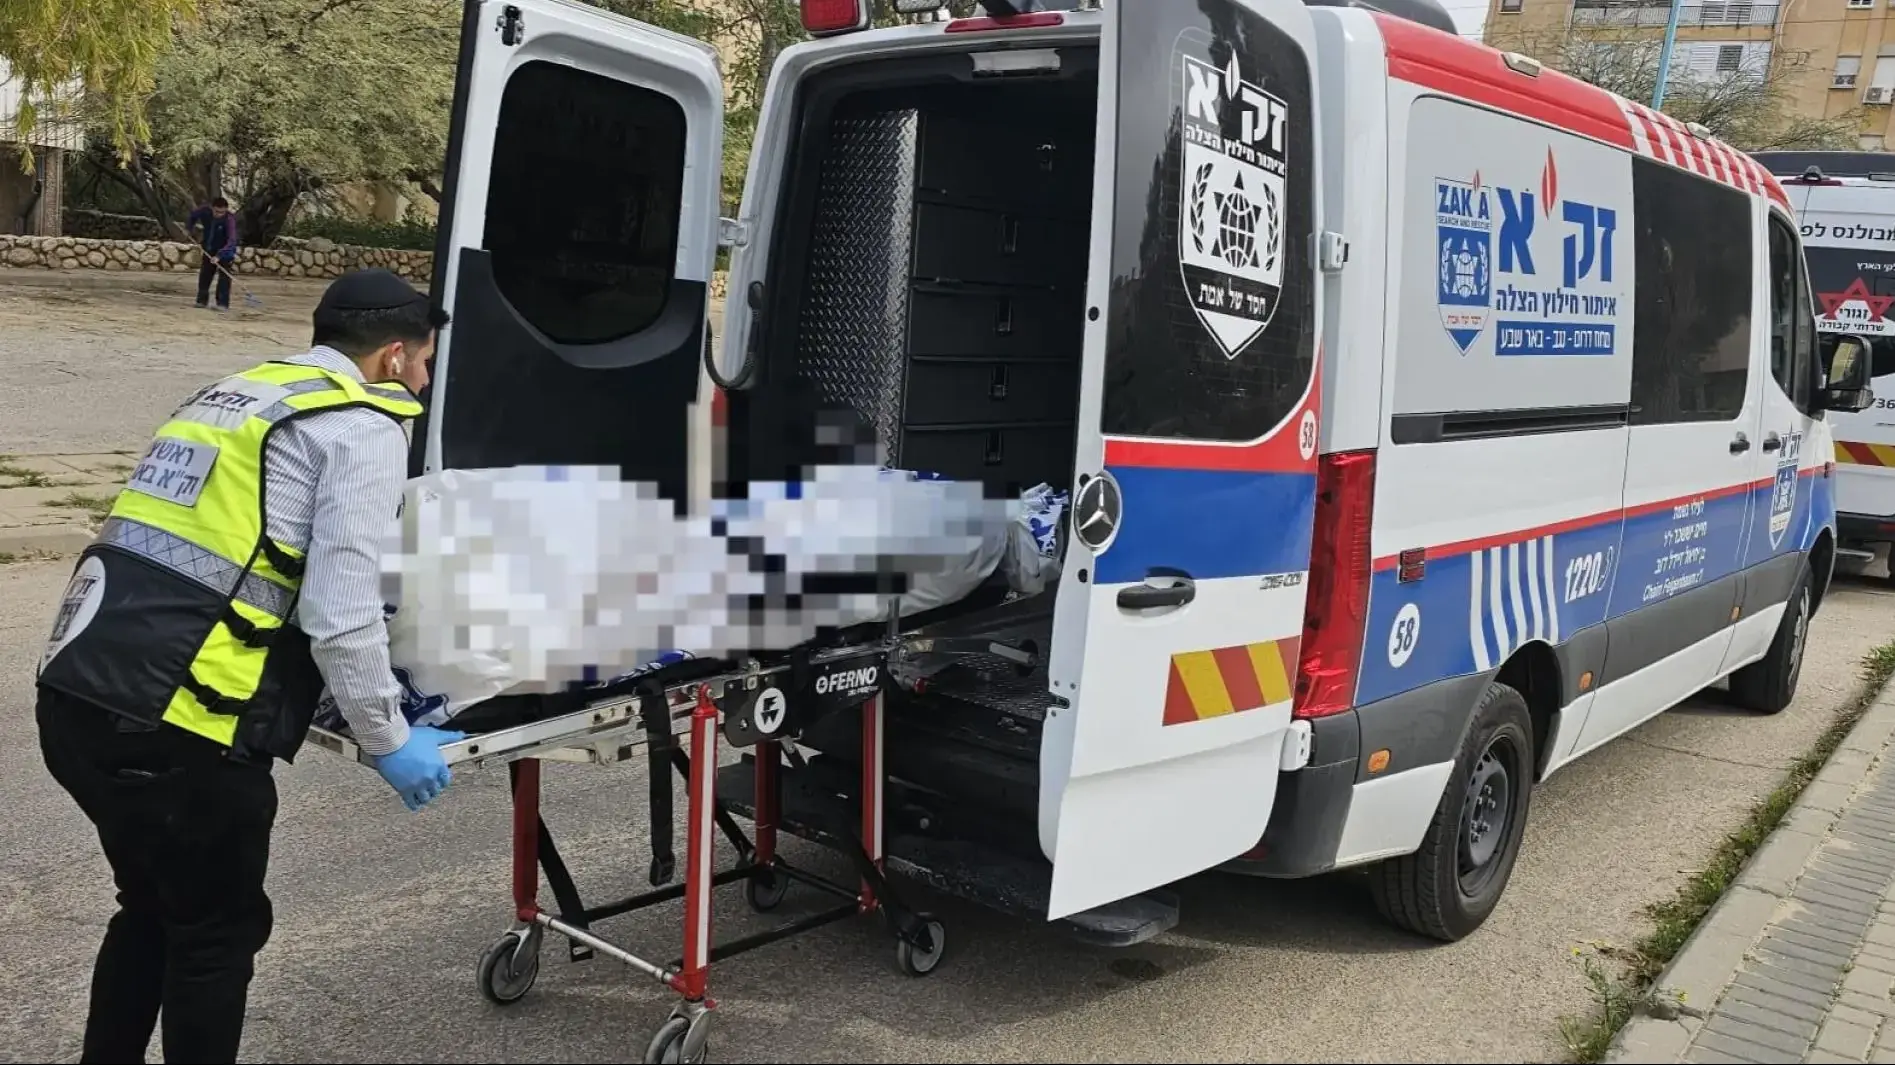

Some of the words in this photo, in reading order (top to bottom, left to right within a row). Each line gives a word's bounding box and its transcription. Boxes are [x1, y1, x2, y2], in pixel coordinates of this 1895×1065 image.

[1186, 124, 1221, 149] הצלה
[1224, 138, 1255, 163] חילוץ
[1256, 151, 1285, 176] איתור
[1198, 283, 1225, 307] אמת
[1228, 277, 1244, 310] של
[1247, 293, 1266, 316] חסד
[1496, 284, 1538, 313] הצלה
[1542, 287, 1579, 318] חילוץ
[1582, 295, 1617, 316] איתור
[1839, 308, 1869, 319] זגורי
[1500, 327, 1524, 349] שבע
[1525, 328, 1544, 349] באר
[1302, 421, 1314, 449] 58
[1565, 551, 1602, 604] 1220
[1392, 615, 1415, 655] 58
[828, 666, 877, 693] FERNO
